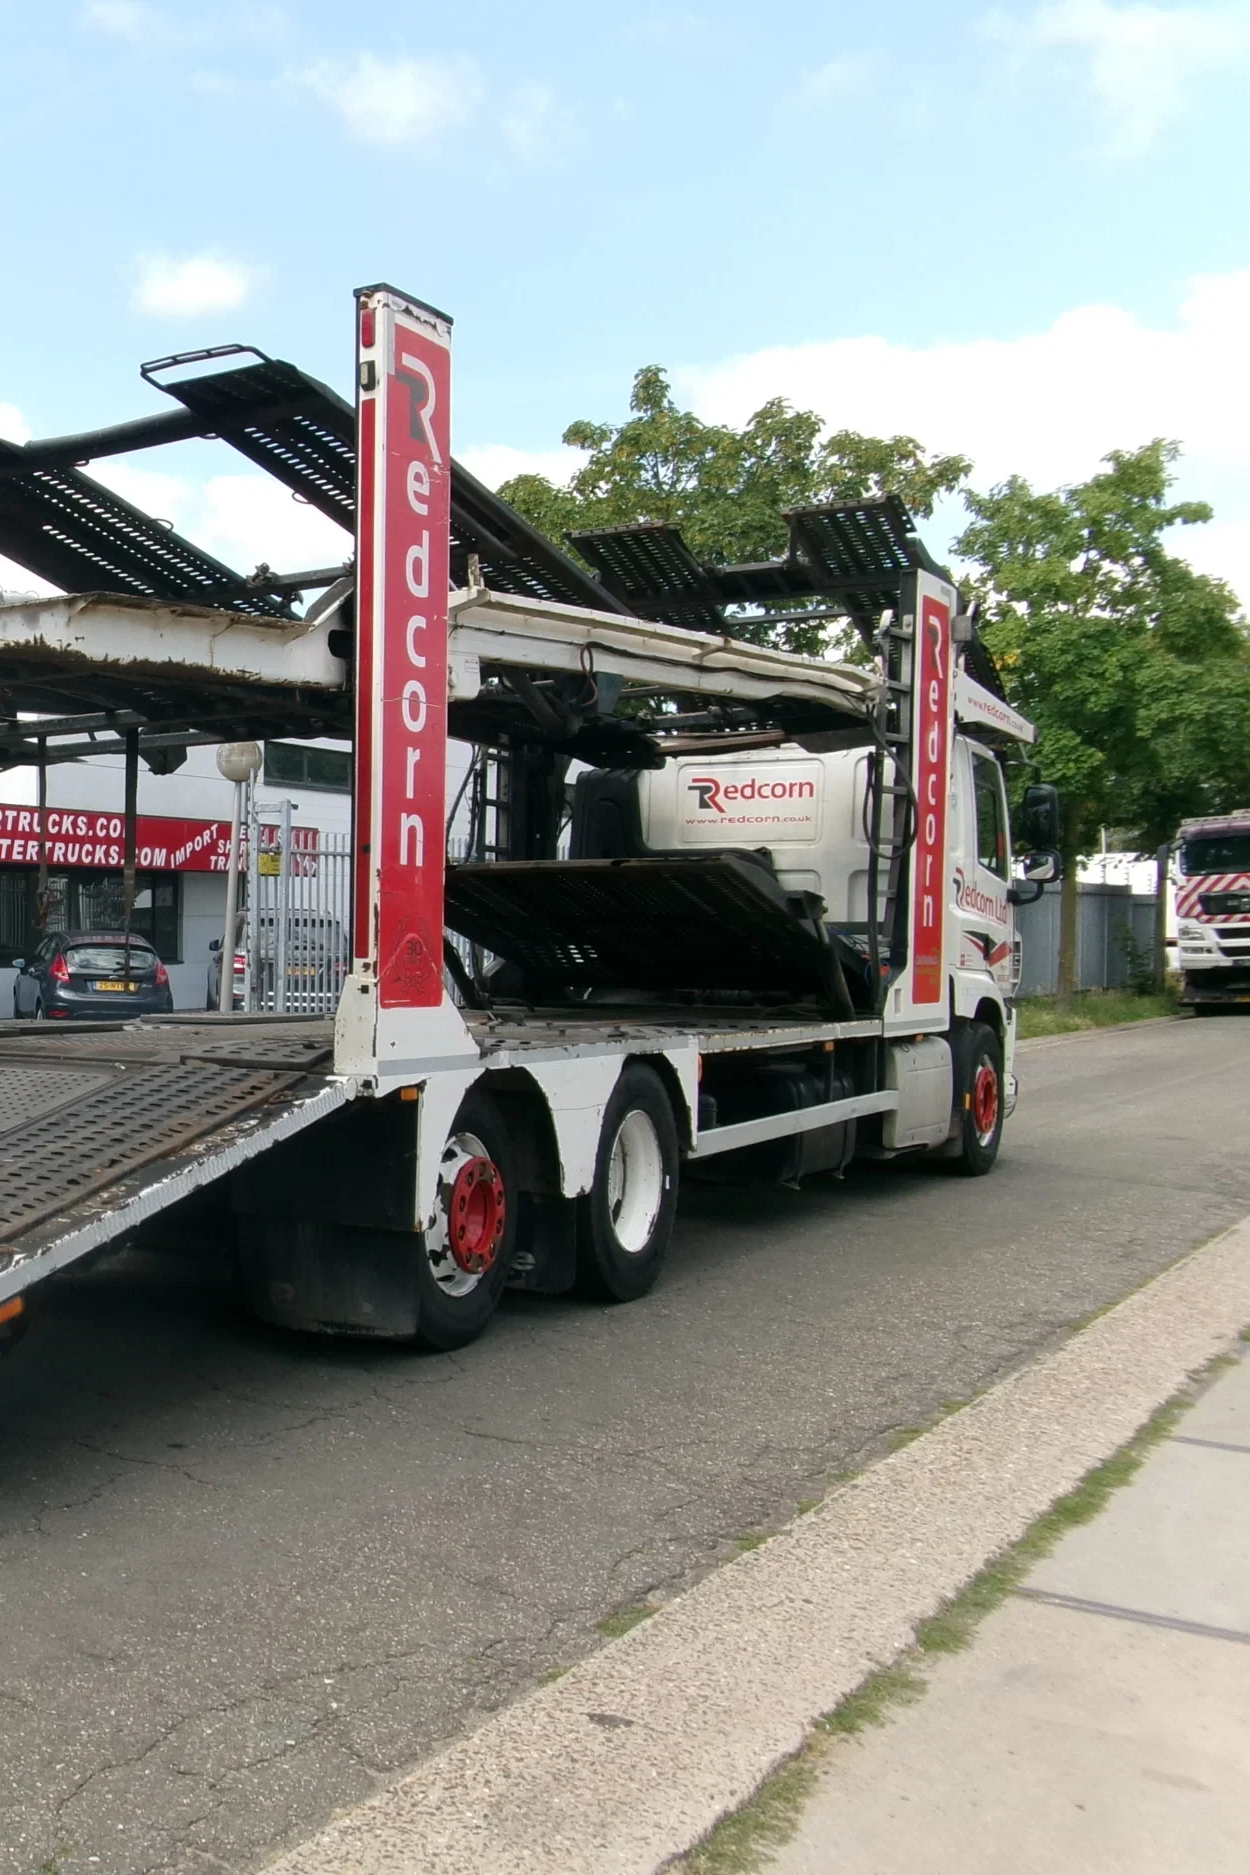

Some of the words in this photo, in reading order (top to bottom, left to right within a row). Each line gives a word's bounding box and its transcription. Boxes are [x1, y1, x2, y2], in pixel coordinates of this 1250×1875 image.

[396, 352, 442, 867] Redcorn
[923, 615, 943, 927] Redcorn
[685, 815, 812, 824] www.redcorn.co.uk
[688, 778, 814, 813] Redcorn
[170, 823, 218, 868] IMPORT
[953, 866, 994, 917] Redcorn
